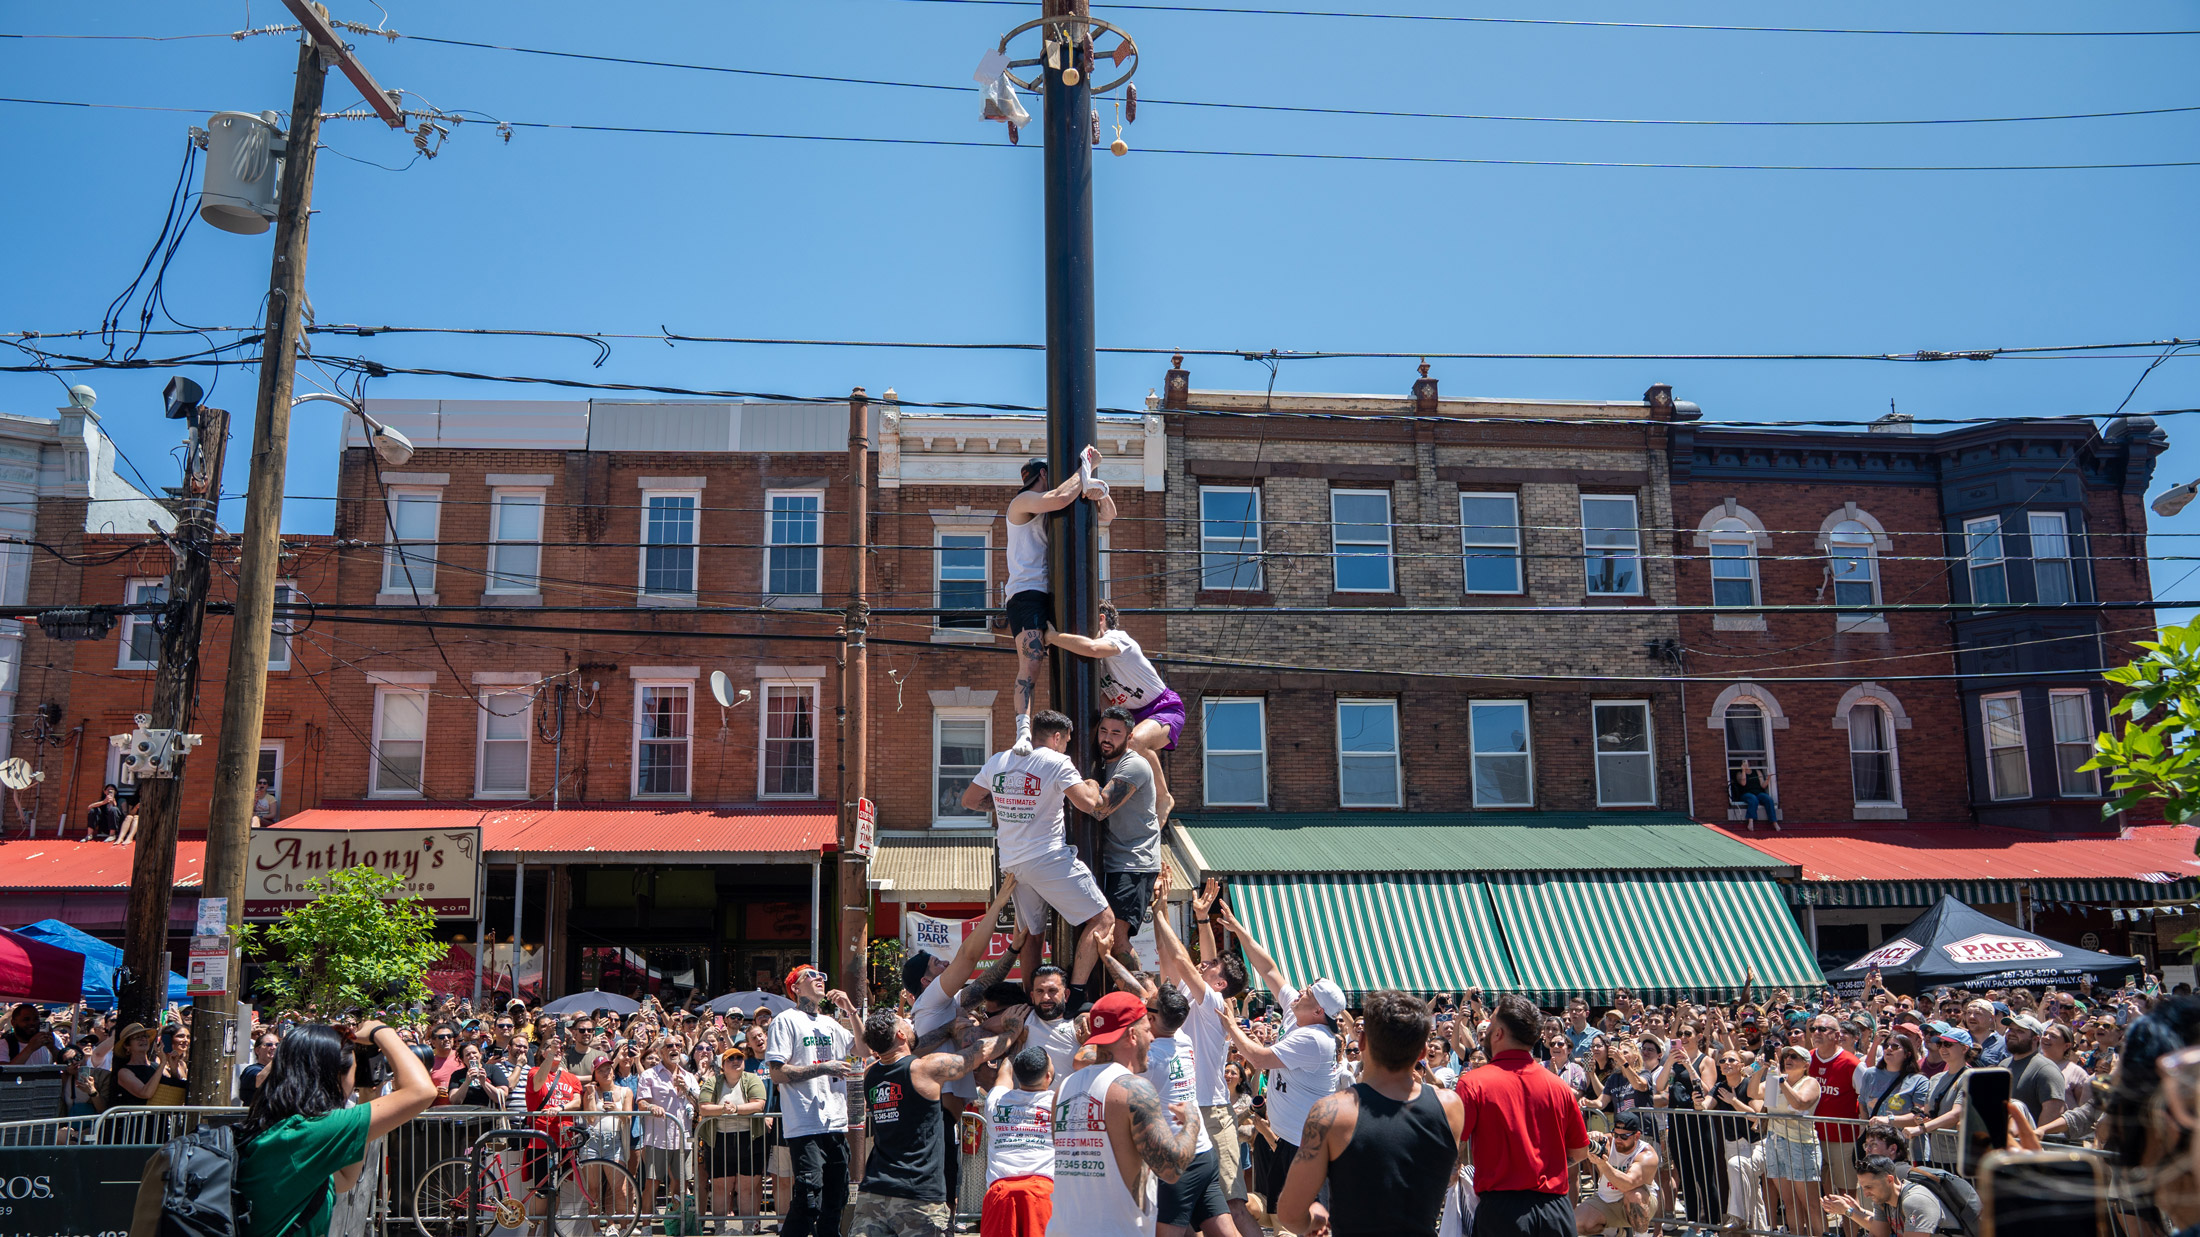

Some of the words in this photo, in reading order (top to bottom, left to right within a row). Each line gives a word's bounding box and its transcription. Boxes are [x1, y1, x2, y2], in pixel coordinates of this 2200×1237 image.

[1000, 775, 1032, 788] PACE
[1006, 798, 1036, 806] ESTIMATES
[255, 837, 444, 881] Anthony's
[917, 923, 948, 934] DEER
[917, 933, 949, 944] PARK
[1962, 941, 2034, 956] PACE
[1967, 953, 2048, 961] ROOFING
[2001, 968, 2057, 978] 267-345-8270
[1964, 975, 2098, 989] WWW.PACEROOFINGPHILLY.CM
[803, 1036, 832, 1047] GREASE
[873, 1086, 896, 1097] PACE
[1820, 1085, 1839, 1096] ons
[1062, 1102, 1095, 1120] PACE
[1067, 1138, 1104, 1147] ESTIMATES
[1055, 1160, 1105, 1169] 67-345-8270
